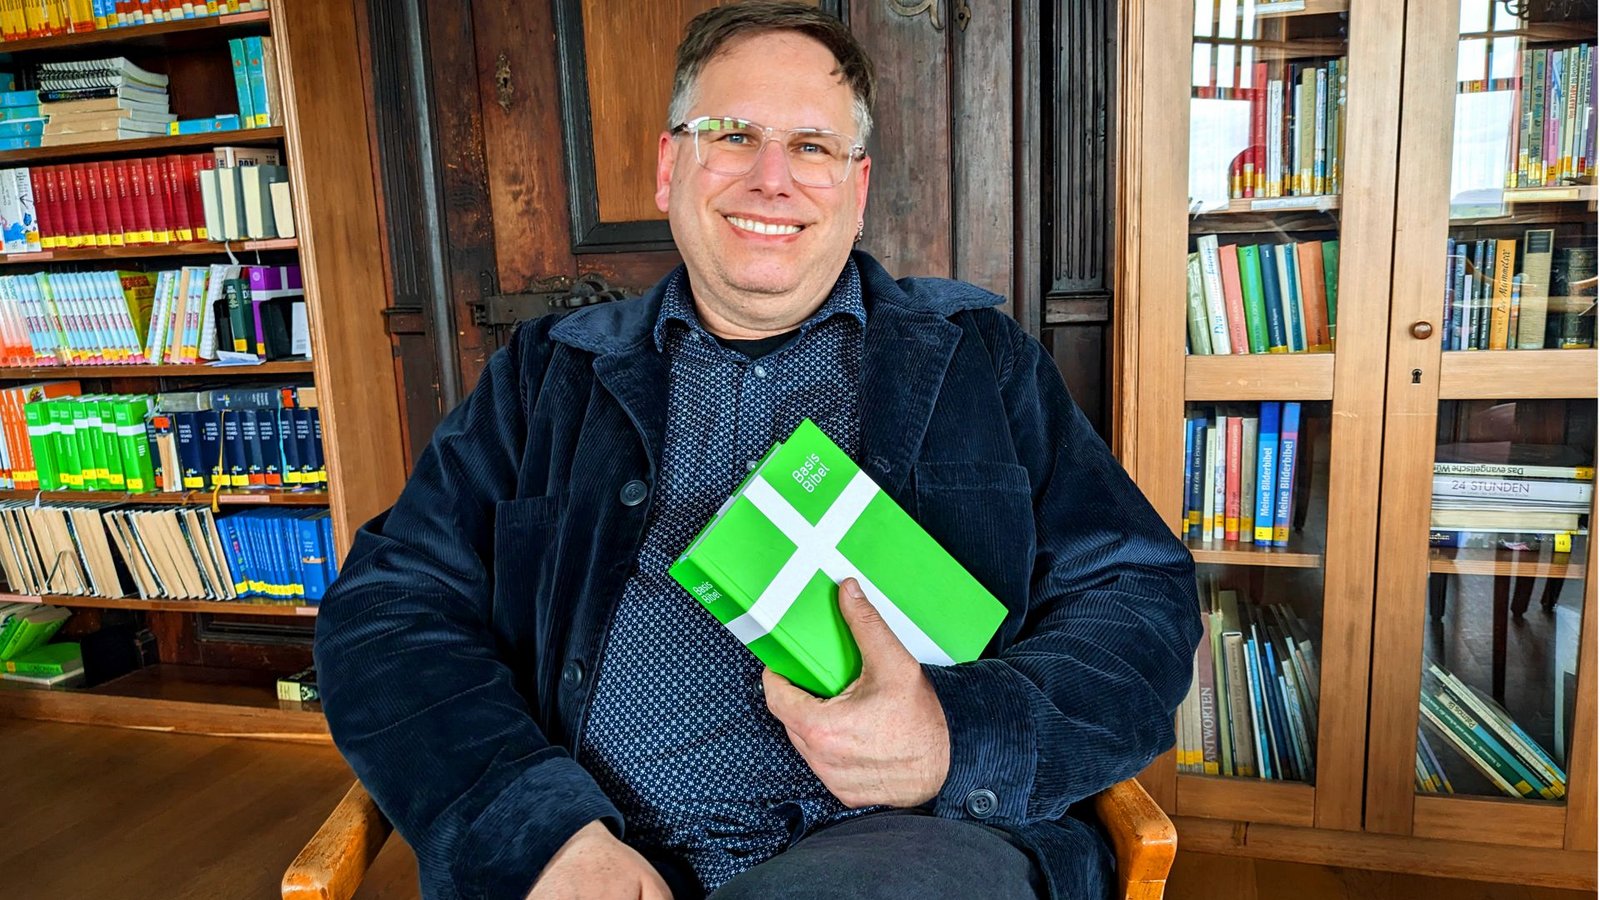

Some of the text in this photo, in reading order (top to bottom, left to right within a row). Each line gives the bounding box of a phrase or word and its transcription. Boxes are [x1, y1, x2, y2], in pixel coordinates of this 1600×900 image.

[792, 453, 820, 483] Basis
[802, 462, 830, 493] Bibel
[1278, 440, 1293, 518] Meine Bilderbibel
[1452, 465, 1507, 475] evangelische
[1508, 466, 1524, 475] Das
[1260, 447, 1273, 516] Meine Bilderbibel
[1452, 480, 1530, 493] 24 STUNDEN
[693, 581, 713, 596] Basis
[701, 589, 722, 604] Bibel
[1201, 687, 1215, 762] ANTWORTEN
[1453, 707, 1476, 729] Patmos
